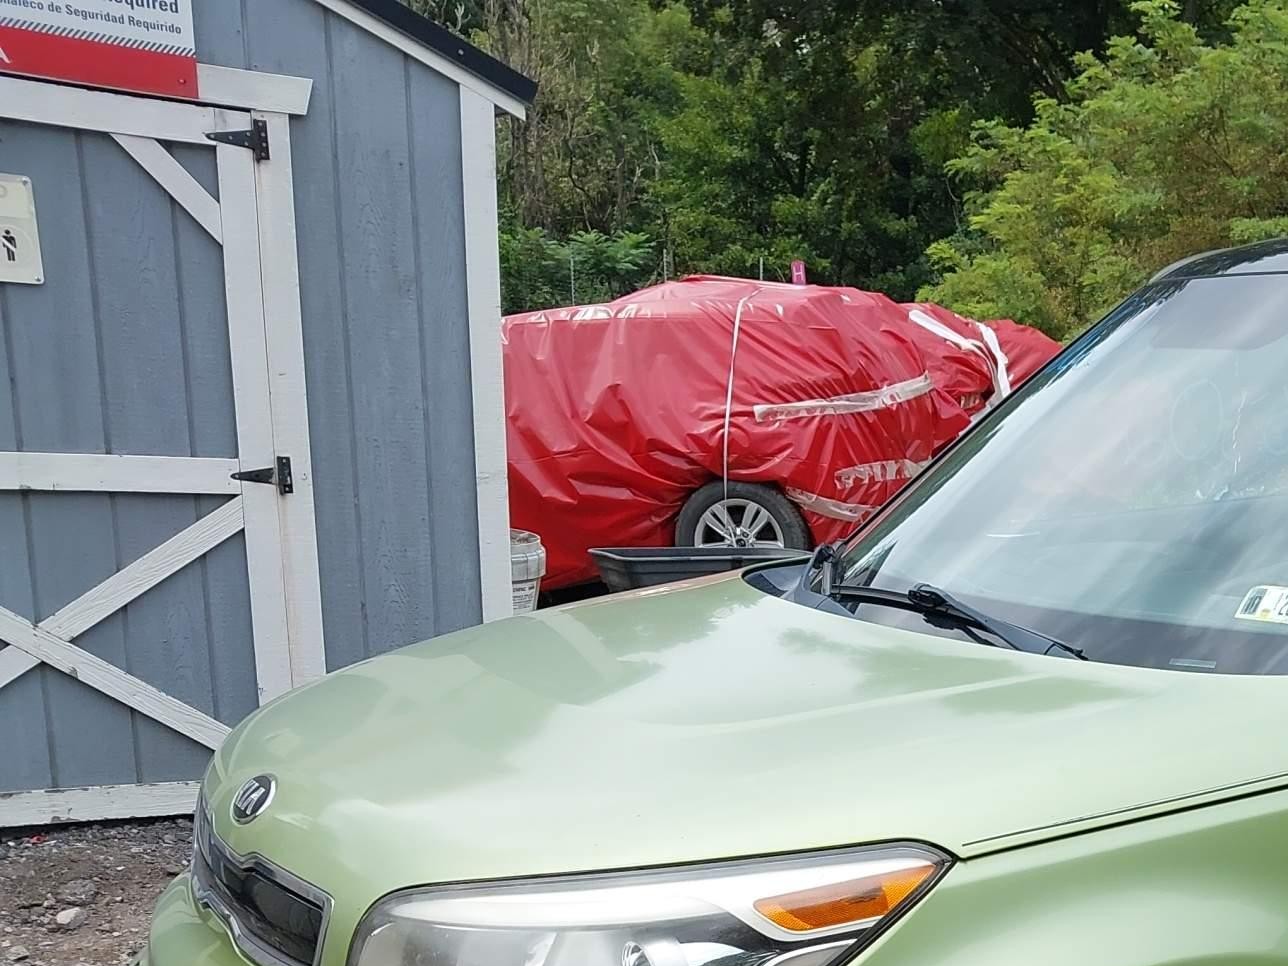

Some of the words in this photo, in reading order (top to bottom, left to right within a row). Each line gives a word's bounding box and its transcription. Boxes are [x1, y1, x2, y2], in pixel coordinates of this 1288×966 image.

[48, 2, 61, 13] de
[65, 4, 125, 25] Seguridad
[128, 15, 182, 34] Requirido
